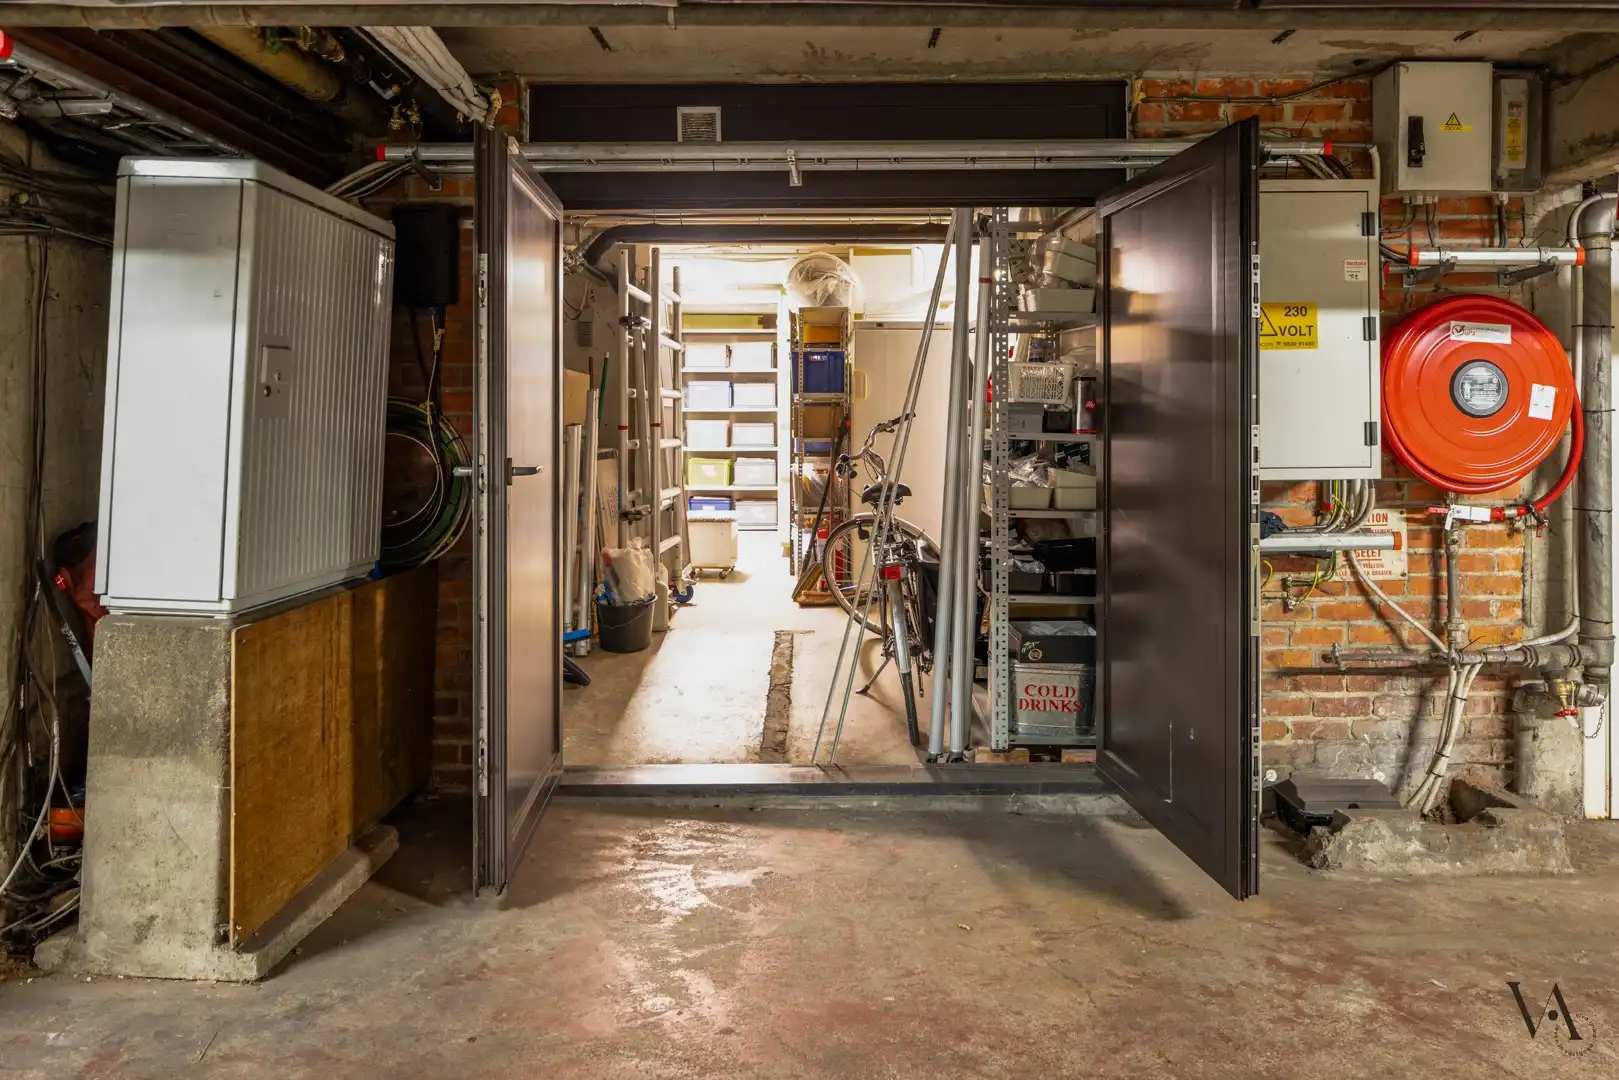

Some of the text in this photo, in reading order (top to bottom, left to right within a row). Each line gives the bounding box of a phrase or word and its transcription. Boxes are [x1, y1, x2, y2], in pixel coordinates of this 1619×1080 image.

[1284, 305, 1308, 317] 230
[1278, 325, 1314, 337] VOLT
[1024, 684, 1077, 698] COLD
[1019, 697, 1082, 713] DRINKS
